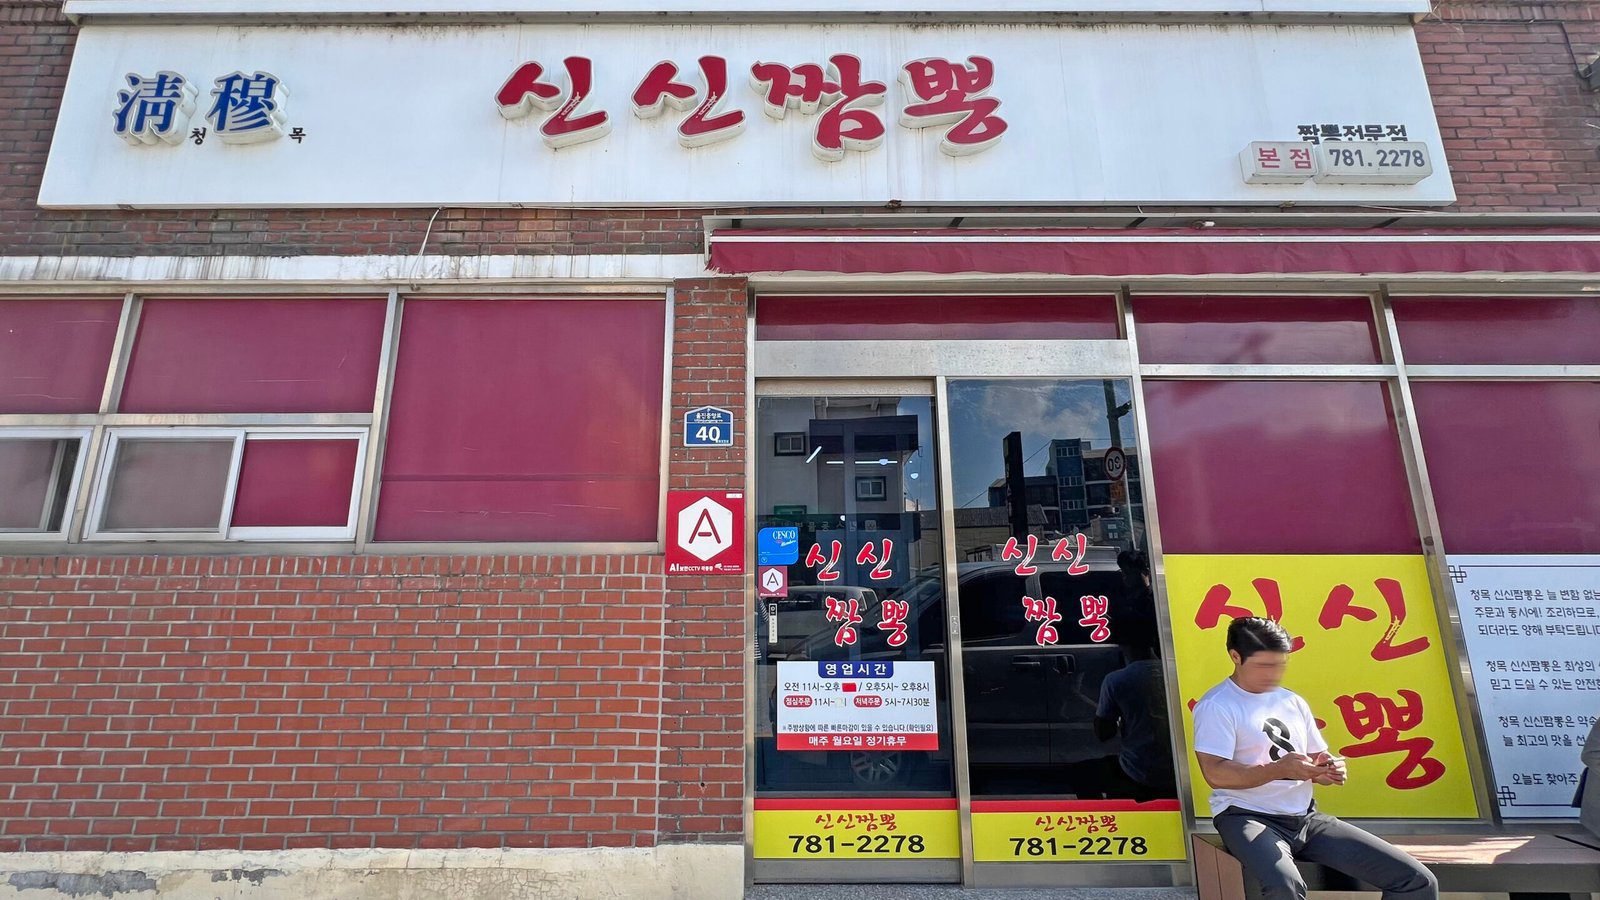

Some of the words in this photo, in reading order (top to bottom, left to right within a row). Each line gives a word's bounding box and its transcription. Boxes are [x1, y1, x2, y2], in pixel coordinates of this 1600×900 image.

[494, 52, 1008, 149] 신신짬뽕
[1329, 149, 1425, 168] 781.2278
[695, 425, 721, 442] 40
[772, 530, 796, 540] CESCO
[804, 538, 895, 582] 신신
[1001, 532, 1090, 577] 신신
[1470, 589, 1490, 601] 청목
[1493, 589, 1543, 601] 신신짬뽕은
[1547, 590, 1557, 601] 늘
[1560, 589, 1579, 601] 변함
[1474, 606, 1505, 618] 주문과
[1508, 606, 1542, 618] 동시에!
[825, 595, 911, 648] 짬뽕
[1022, 595, 1111, 648] 짬뽕
[1478, 624, 1519, 636] 되더라도
[1522, 624, 1543, 636] 양해
[825, 663, 887, 676] 영업시간
[1486, 660, 1507, 672] 청목
[1510, 660, 1561, 672] 신신짬뽕은
[1564, 660, 1595, 672] 최상의
[784, 682, 800, 692] 오전
[1490, 679, 1511, 690] 믿고
[1514, 679, 1536, 690] 드실
[1538, 679, 1549, 690] 수
[1551, 678, 1572, 690] 있는
[785, 697, 811, 706] 점심주문
[855, 697, 881, 706] 저녁주문
[885, 697, 930, 707] 5시~7시30분
[1498, 716, 1520, 728] 청목
[1523, 716, 1575, 728] 신신짬뽕은
[808, 736, 829, 746] 매주
[832, 736, 863, 746] 월요일
[866, 736, 907, 746] 정기휴무
[1517, 735, 1548, 746] 최고의
[1551, 734, 1573, 746] 맛을
[1512, 773, 1544, 785] 오늘도
[814, 812, 897, 832] 신신짬뽕
[1034, 814, 1118, 833] 신신짬뽕
[788, 834, 926, 854] 781-2278
[1008, 836, 1148, 856] 781-2278
